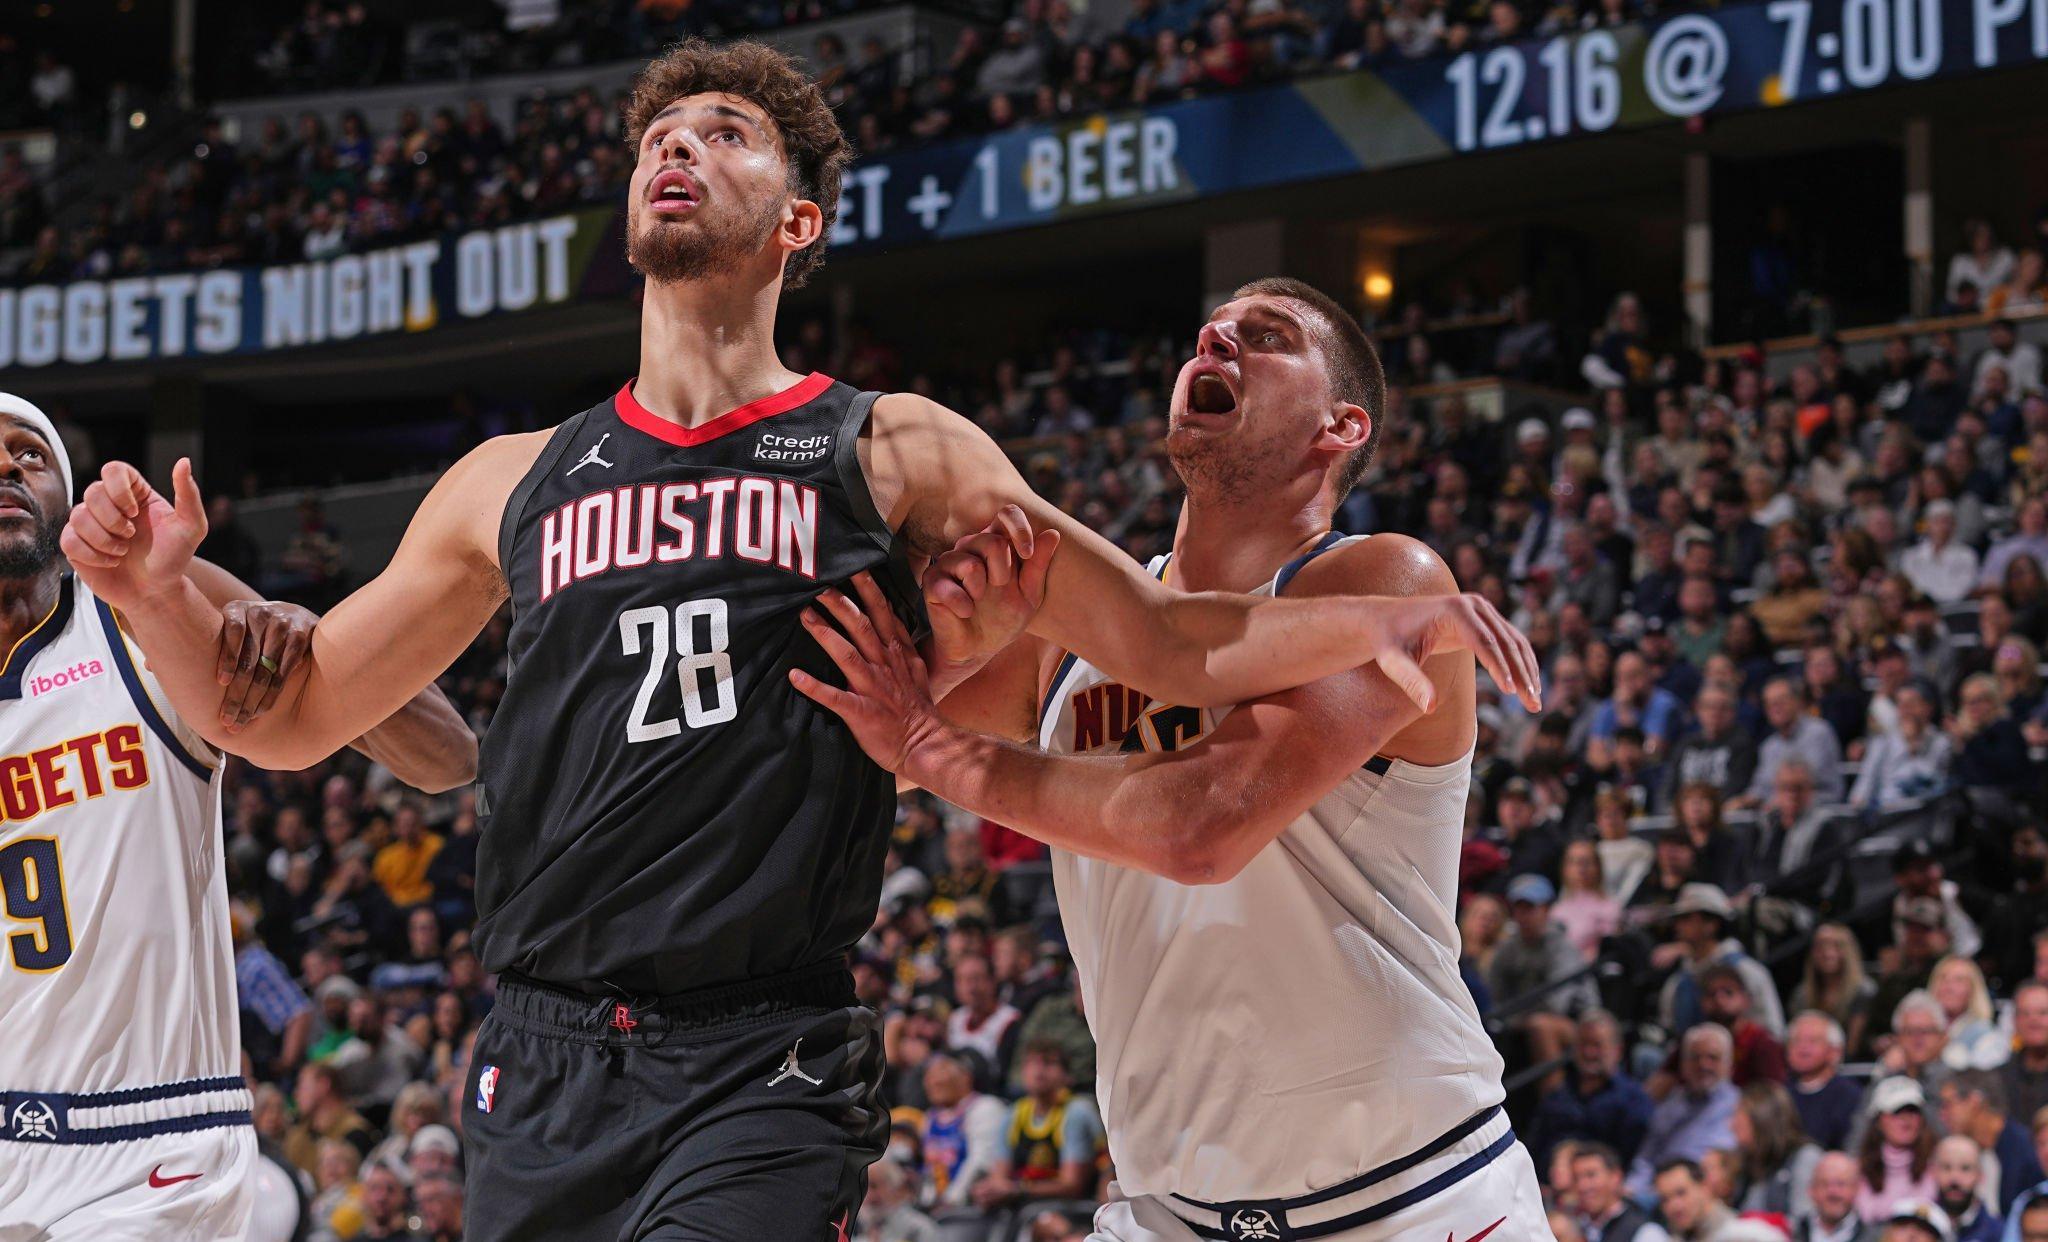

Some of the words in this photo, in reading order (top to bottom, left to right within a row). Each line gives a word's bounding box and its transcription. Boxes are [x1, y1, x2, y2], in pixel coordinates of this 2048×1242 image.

[1445, 31, 1621, 152] 12.16
[1643, 14, 1729, 117] @
[1767, 0, 1942, 100] 7:00
[906, 175, 952, 230] +
[974, 144, 1000, 220] 1
[1026, 117, 1179, 211] BEER
[262, 240, 440, 348] NIGHT
[456, 215, 578, 317] OUT
[754, 443, 827, 461] karma
[762, 434, 831, 449] credit
[541, 476, 820, 604] HOUSTON
[30, 658, 104, 698] ibotta
[619, 598, 738, 744] 28
[0, 723, 150, 826] GETS
